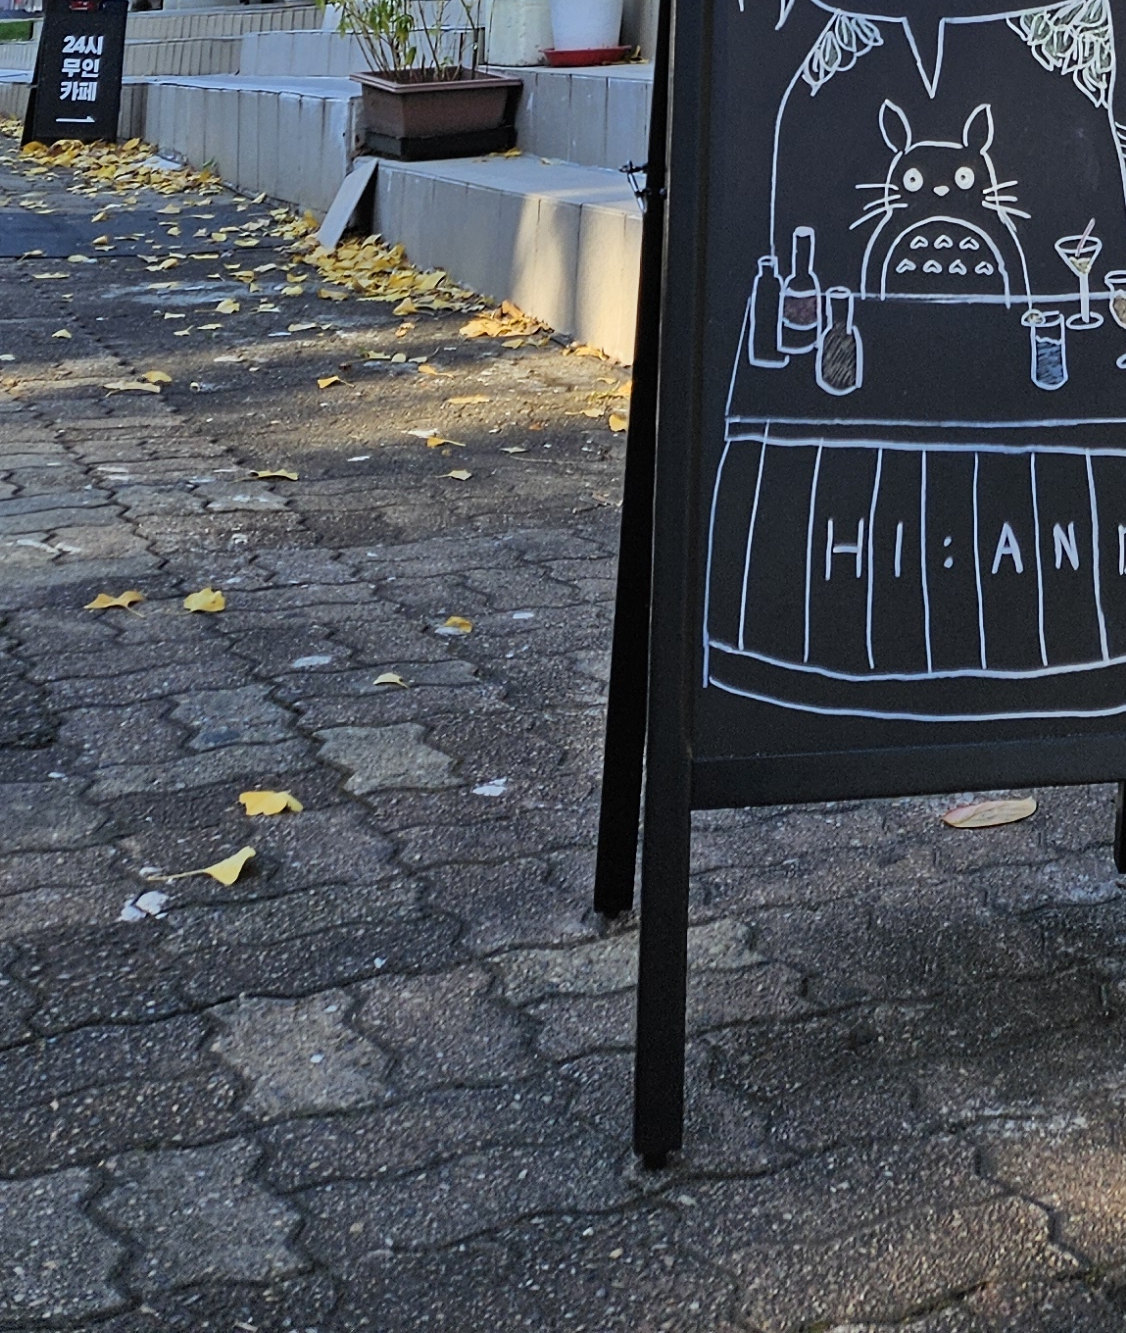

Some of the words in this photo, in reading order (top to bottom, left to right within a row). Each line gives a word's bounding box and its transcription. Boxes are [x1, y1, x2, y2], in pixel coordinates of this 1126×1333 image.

[62, 35, 104, 55] 24시
[61, 58, 101, 78] 무인
[59, 80, 98, 102] 카페
